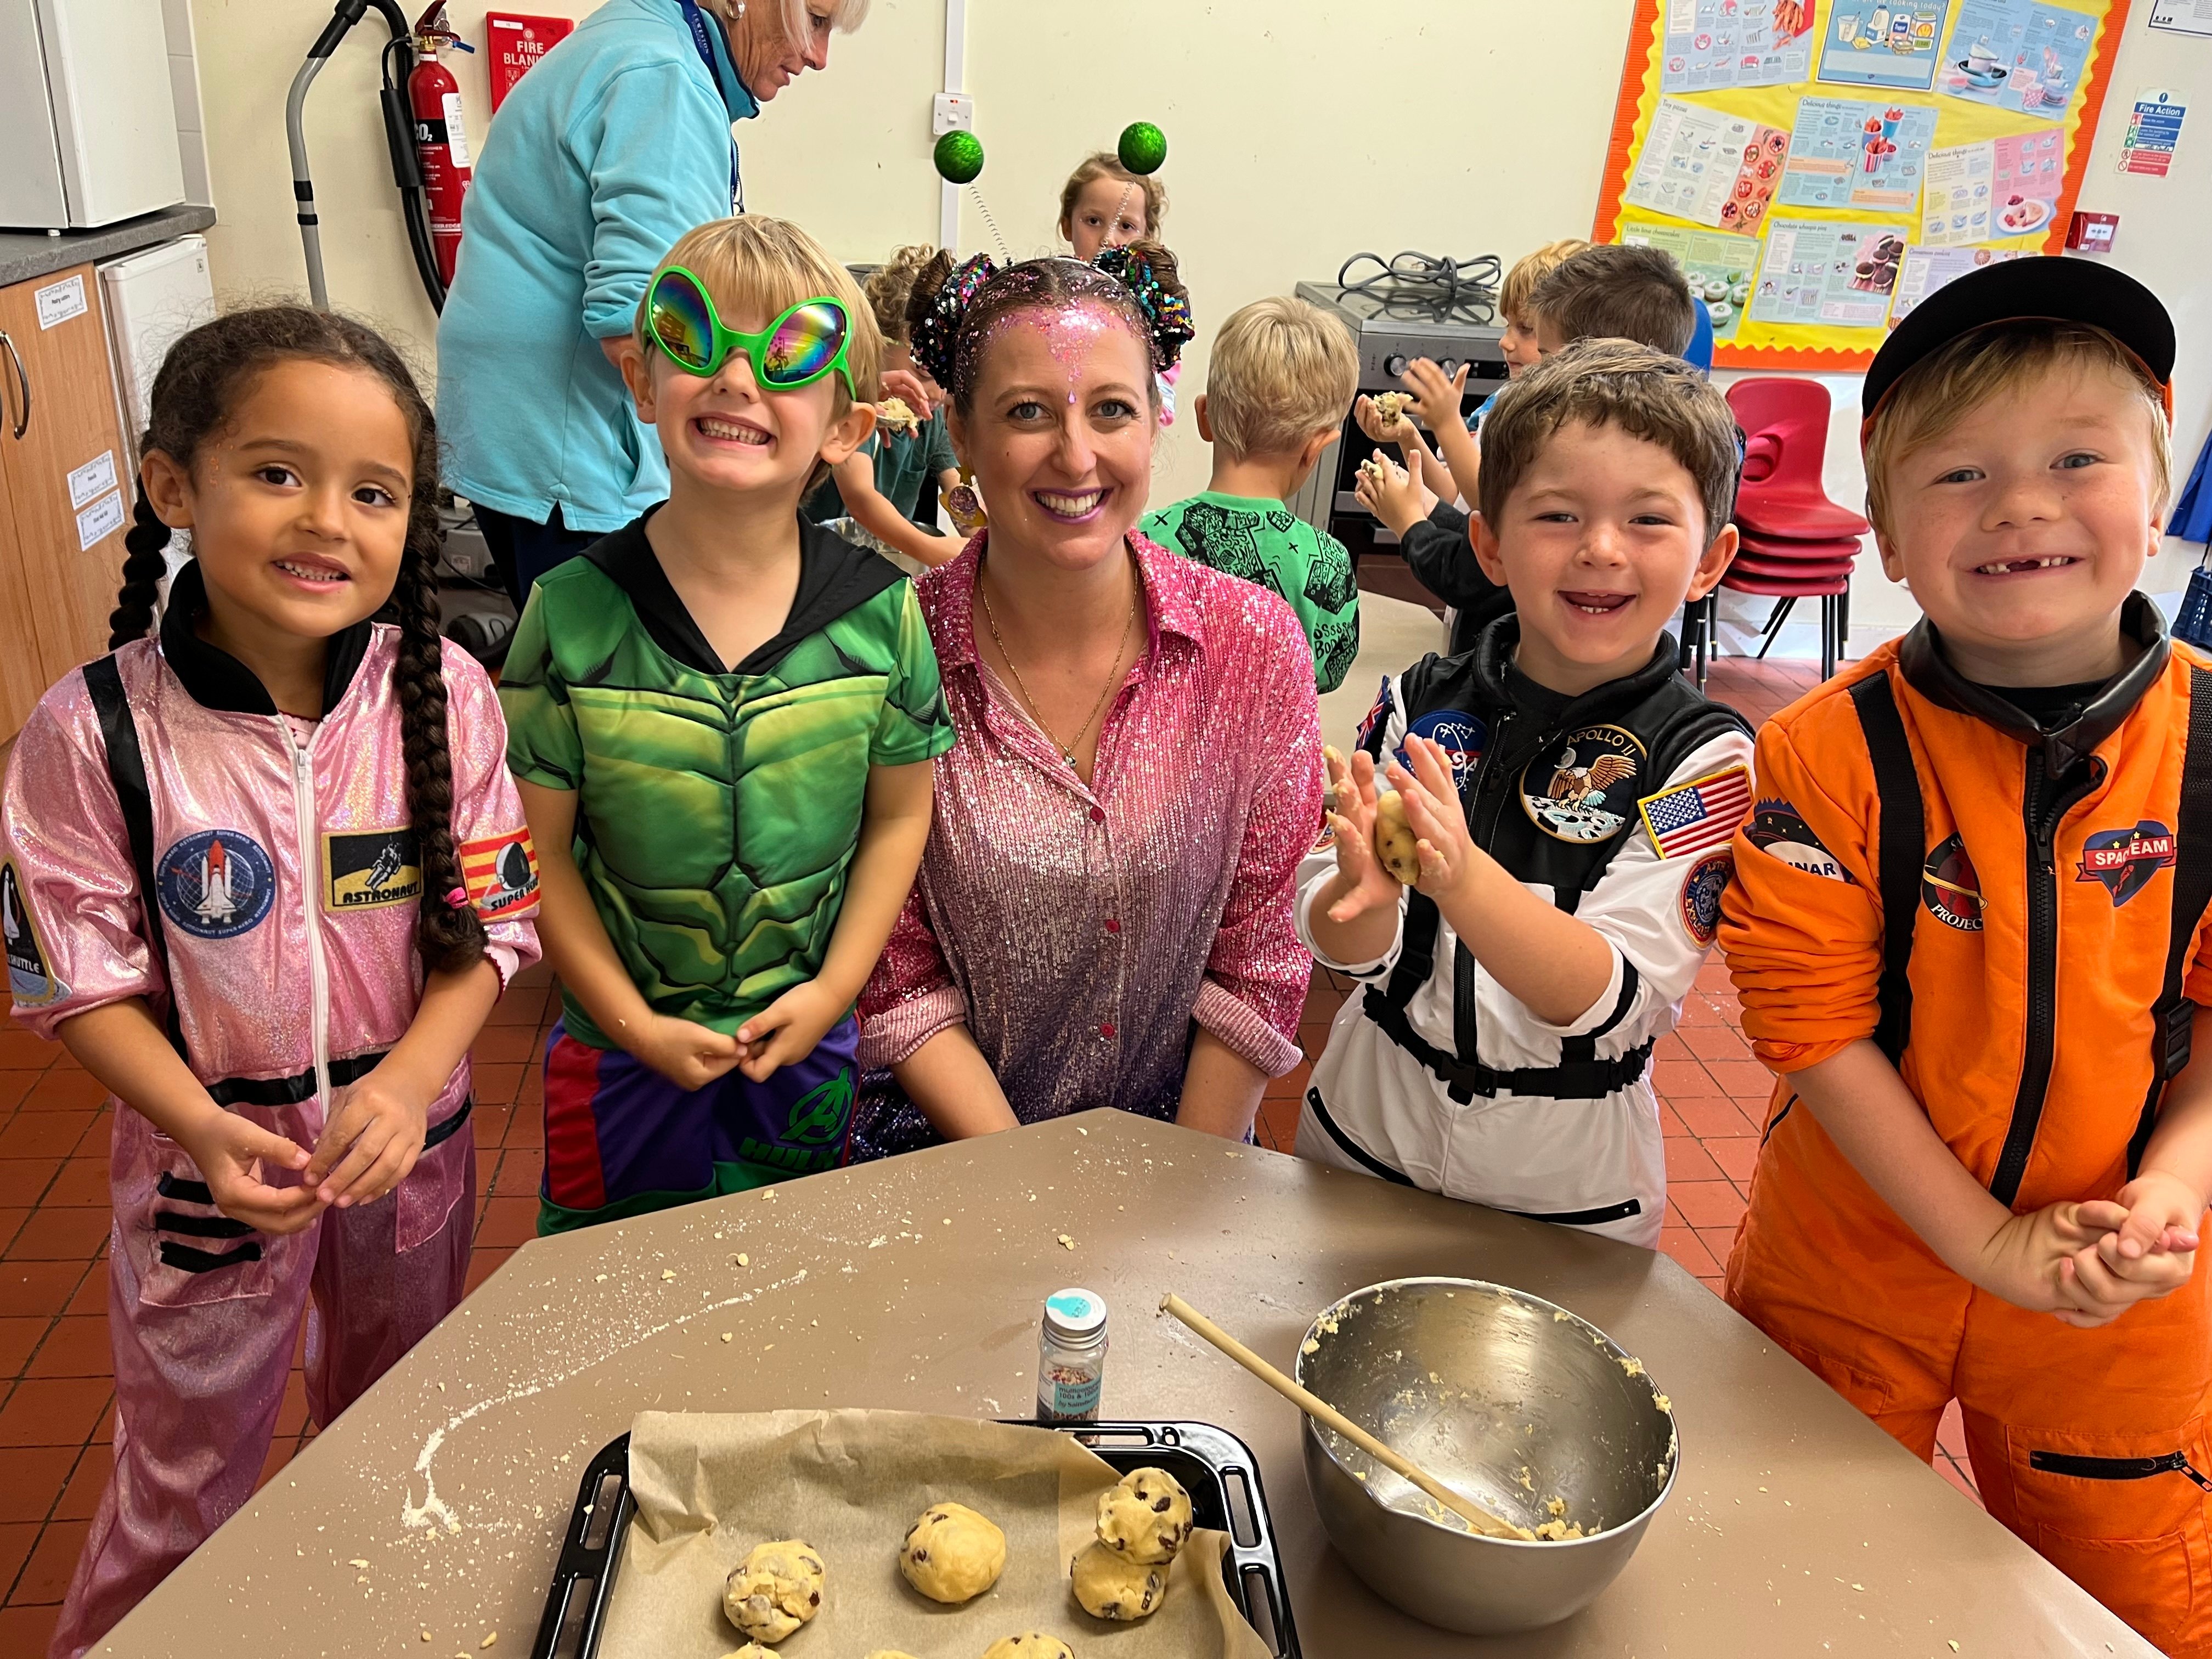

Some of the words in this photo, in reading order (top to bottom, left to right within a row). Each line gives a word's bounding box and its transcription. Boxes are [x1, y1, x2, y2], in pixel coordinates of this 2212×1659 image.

[1921, 2, 1945, 12] today?
[516, 40, 544, 54] FIRE
[503, 52, 543, 66] BLAN
[2138, 104, 2155, 114] Fire
[2155, 105, 2181, 116] Action
[1566, 729, 1624, 747] APOLLO
[2095, 849, 2129, 866] SPAC
[2130, 839, 2169, 856] EAM
[343, 881, 418, 904] ASTRONAUT
[490, 888, 525, 911] SUPER
[238, 918, 253, 929] HERO
[1930, 904, 1983, 930] PROJEC
[740, 1136, 842, 1171] HULK
